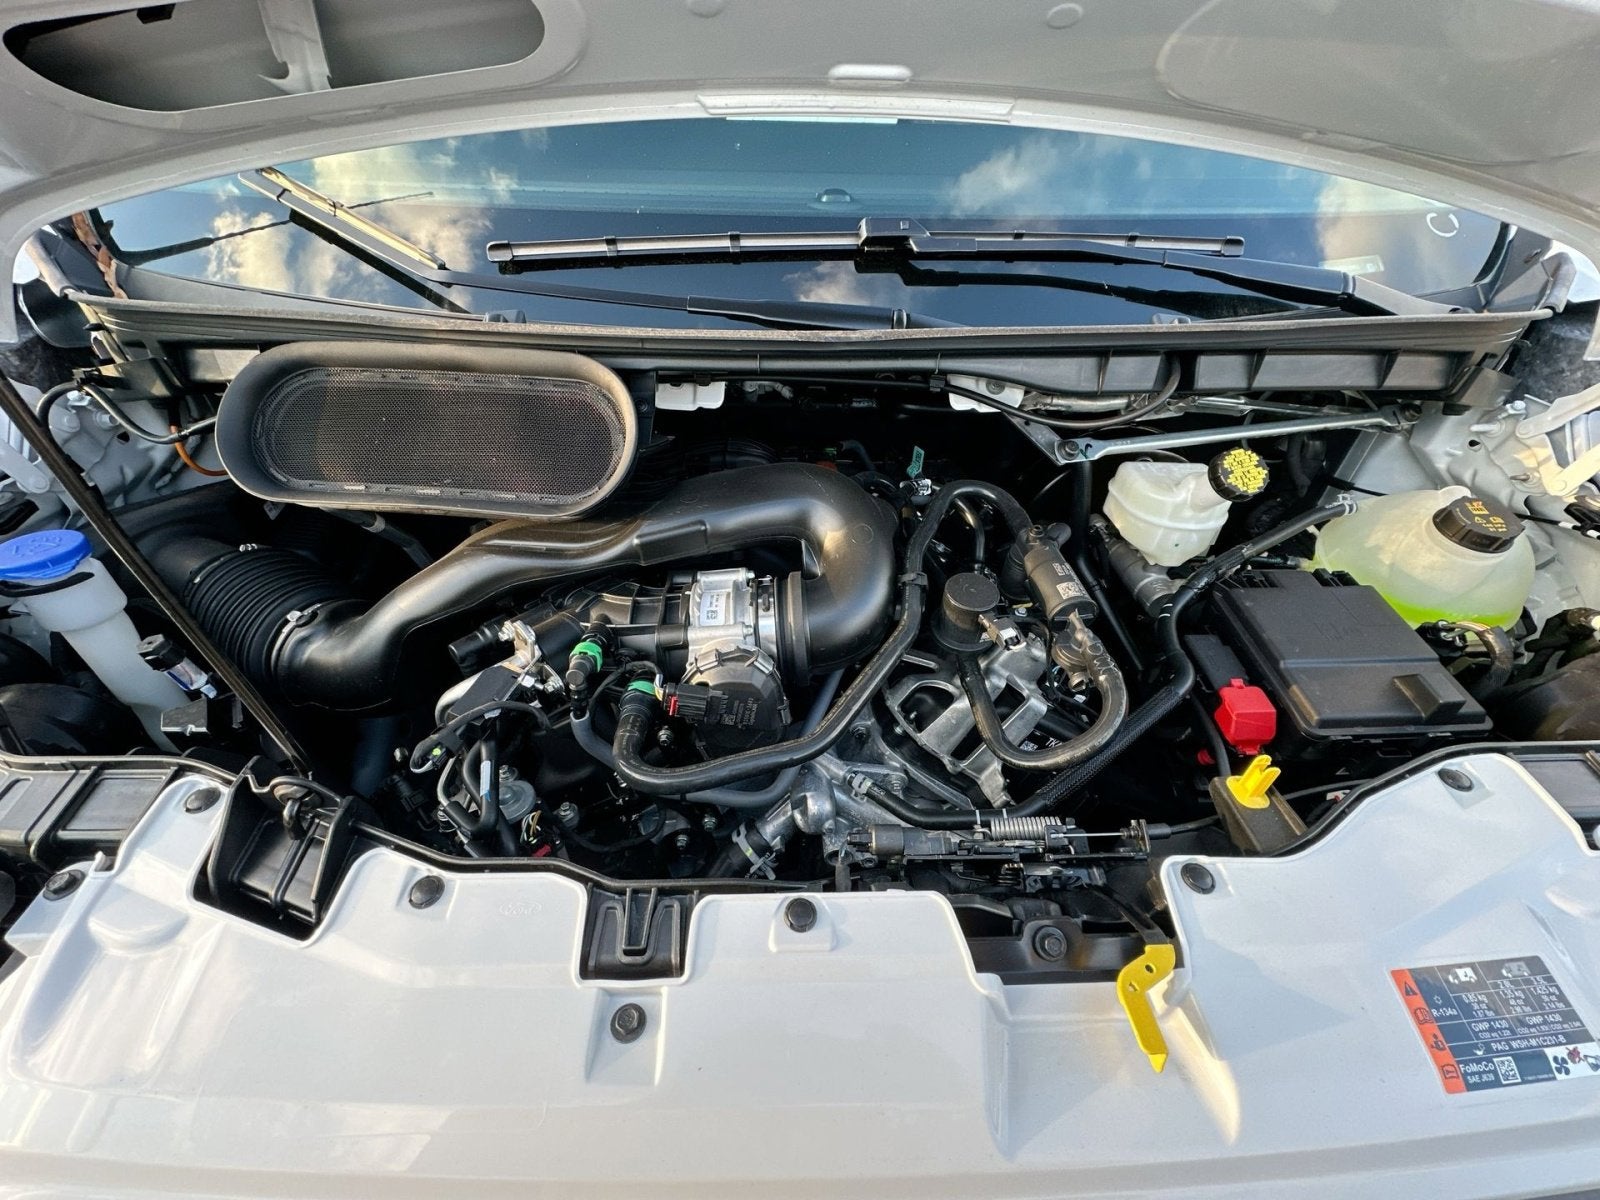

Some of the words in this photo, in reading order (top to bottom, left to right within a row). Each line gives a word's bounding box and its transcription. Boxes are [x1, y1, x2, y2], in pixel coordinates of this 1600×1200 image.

[1431, 1007, 1458, 1017] R-134a
[1525, 1015, 1543, 1025] GWP
[1544, 1013, 1562, 1022] 1430
[1471, 1022, 1490, 1031] GWP
[1491, 1042, 1510, 1051] PAG
[1509, 1034, 1567, 1049] WSH-M1C231-B
[1459, 1061, 1494, 1073] FoMoCo
[1467, 1075, 1481, 1083] SAE
